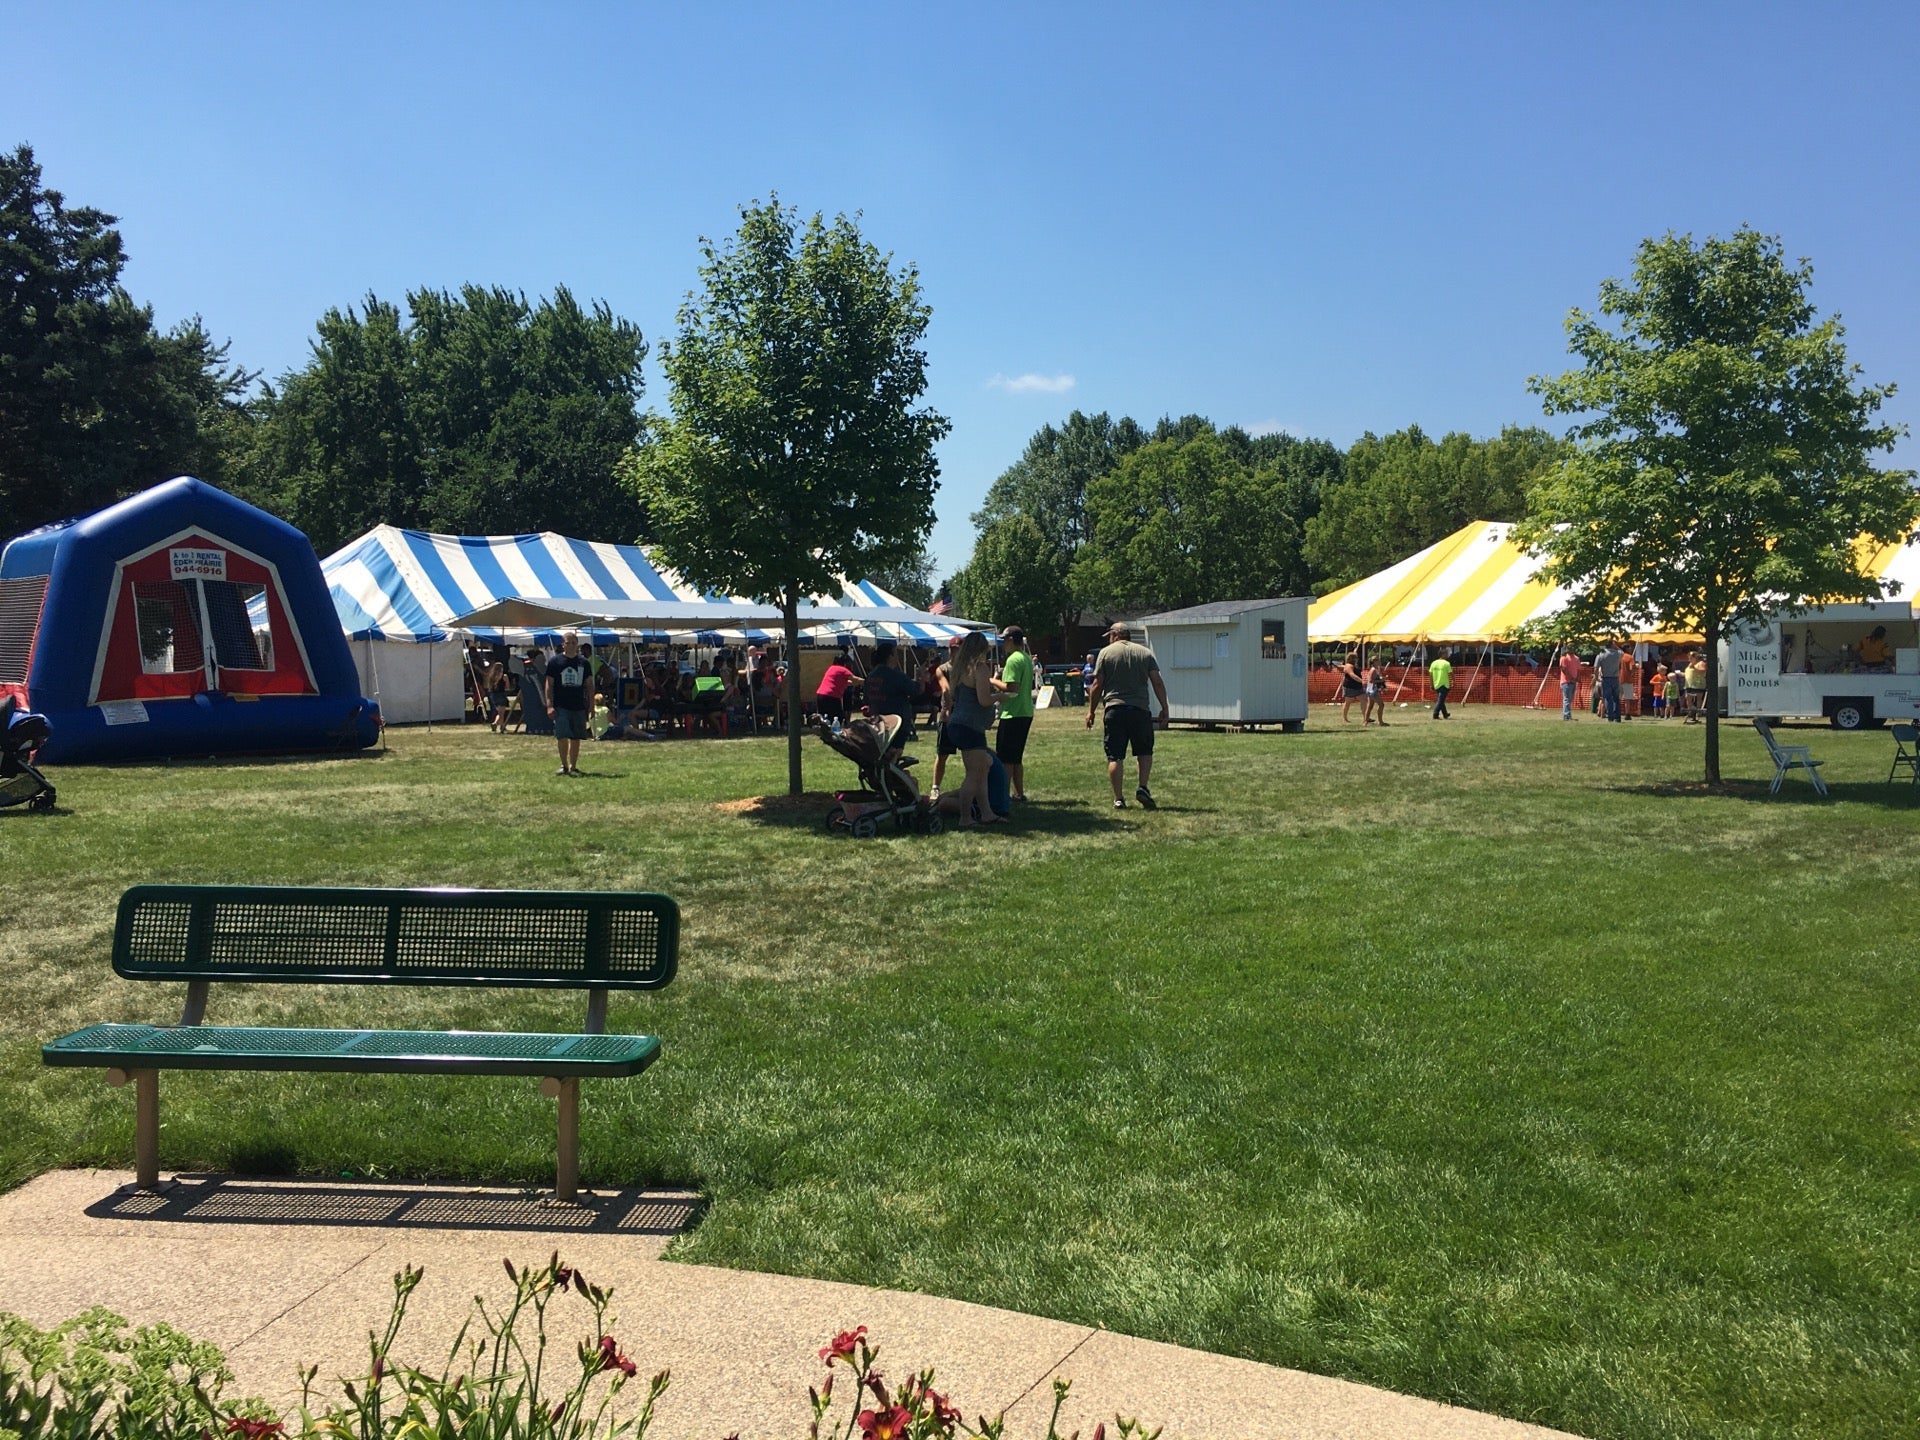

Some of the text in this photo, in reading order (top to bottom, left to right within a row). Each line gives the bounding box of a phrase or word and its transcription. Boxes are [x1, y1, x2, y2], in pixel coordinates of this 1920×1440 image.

[196, 552, 222, 560] RENTAL
[1738, 650, 1778, 661] Mike's
[1738, 664, 1765, 674] Mini
[1738, 677, 1780, 688] Donuts
